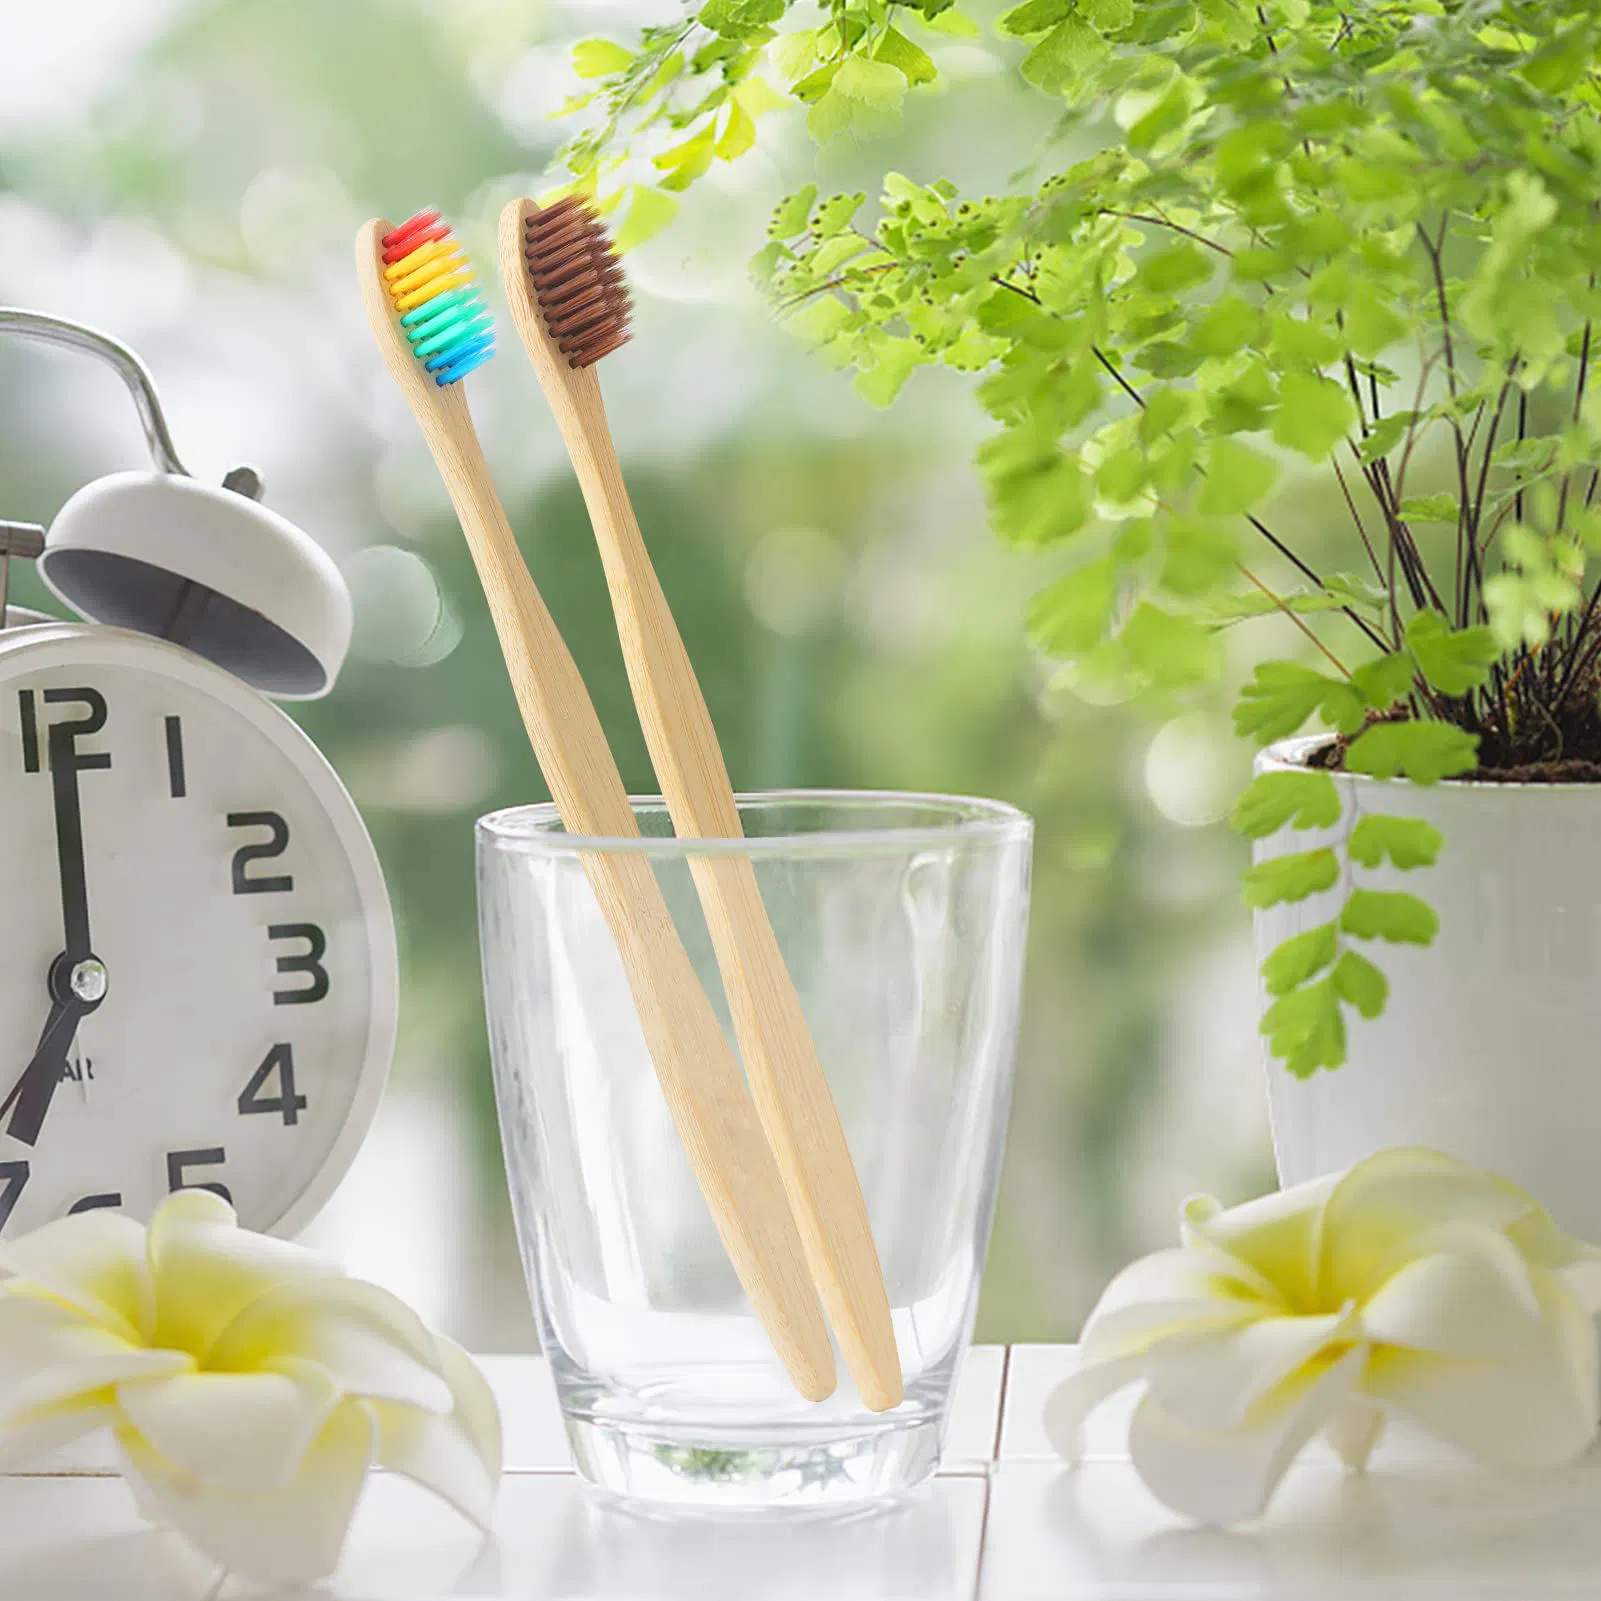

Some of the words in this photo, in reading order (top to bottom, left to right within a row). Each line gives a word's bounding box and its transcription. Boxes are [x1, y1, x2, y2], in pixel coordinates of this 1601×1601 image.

[18, 687, 112, 774] 12
[165, 716, 186, 798] 1
[227, 811, 293, 895] 2
[268, 923, 329, 1006] 3
[238, 1043, 307, 1126] 4
[167, 1147, 233, 1206] 5
